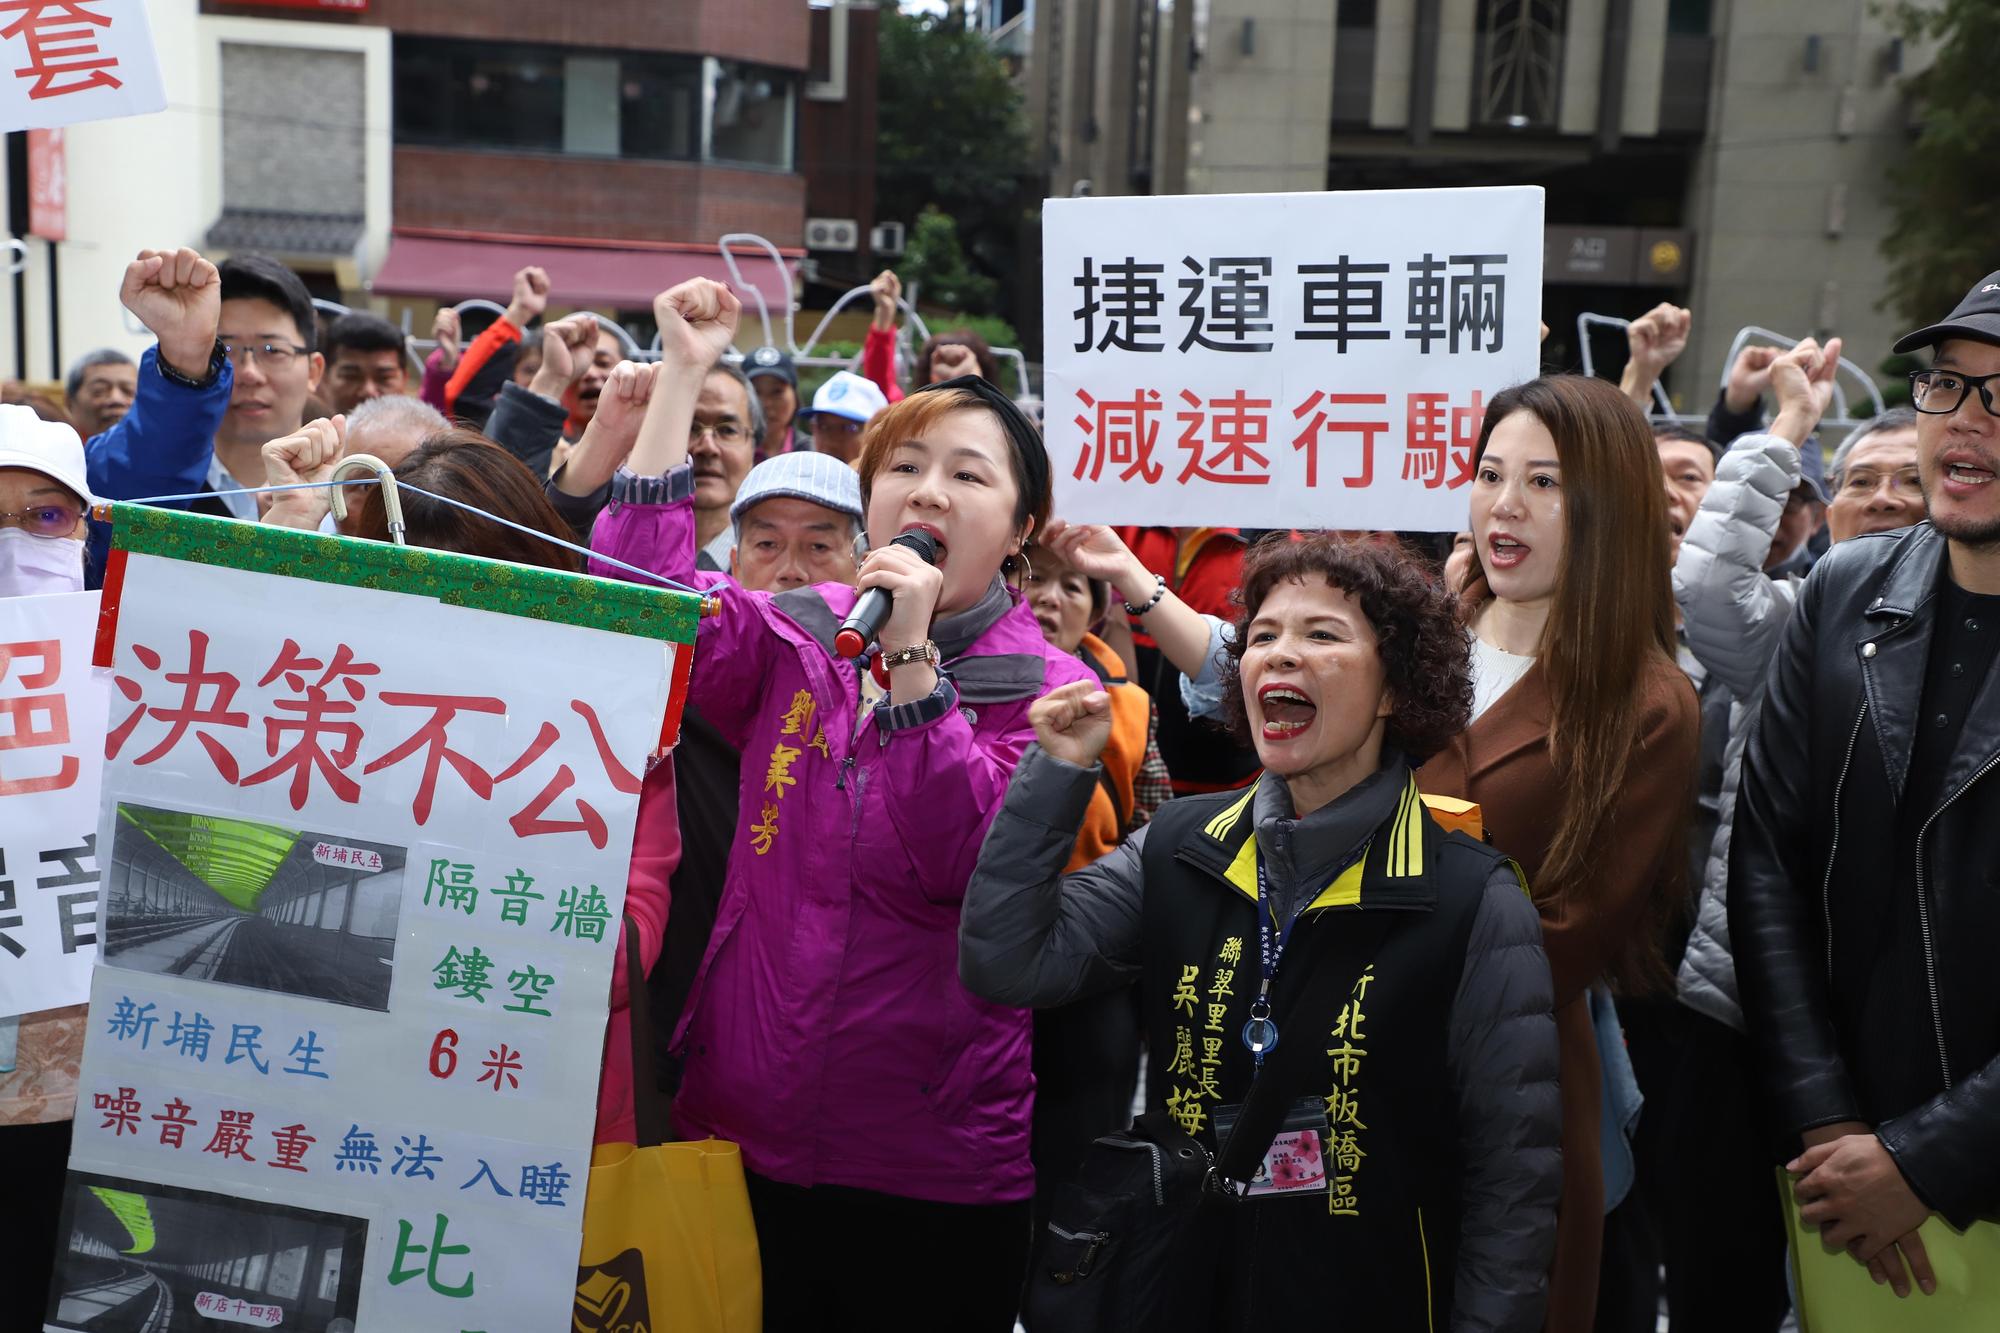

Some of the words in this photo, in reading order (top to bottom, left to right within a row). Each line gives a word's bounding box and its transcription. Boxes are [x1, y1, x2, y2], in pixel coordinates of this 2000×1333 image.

[0, 0, 122, 101] 套
[1072, 253, 1508, 354] 捷運車輛
[1071, 387, 1486, 489] 減速行駛
[104, 629, 642, 850] 決策不公
[315, 843, 383, 869] 新埔民生
[431, 943, 556, 1019] 鏤空
[1199, 936, 1243, 1100] 聯翠里里長
[106, 995, 331, 1081] 新埔民生
[427, 1027, 523, 1092] 6米
[1165, 964, 1208, 1138] 吳麗梅
[386, 1212, 475, 1300] 比
[196, 1293, 281, 1323] 新店十四張
